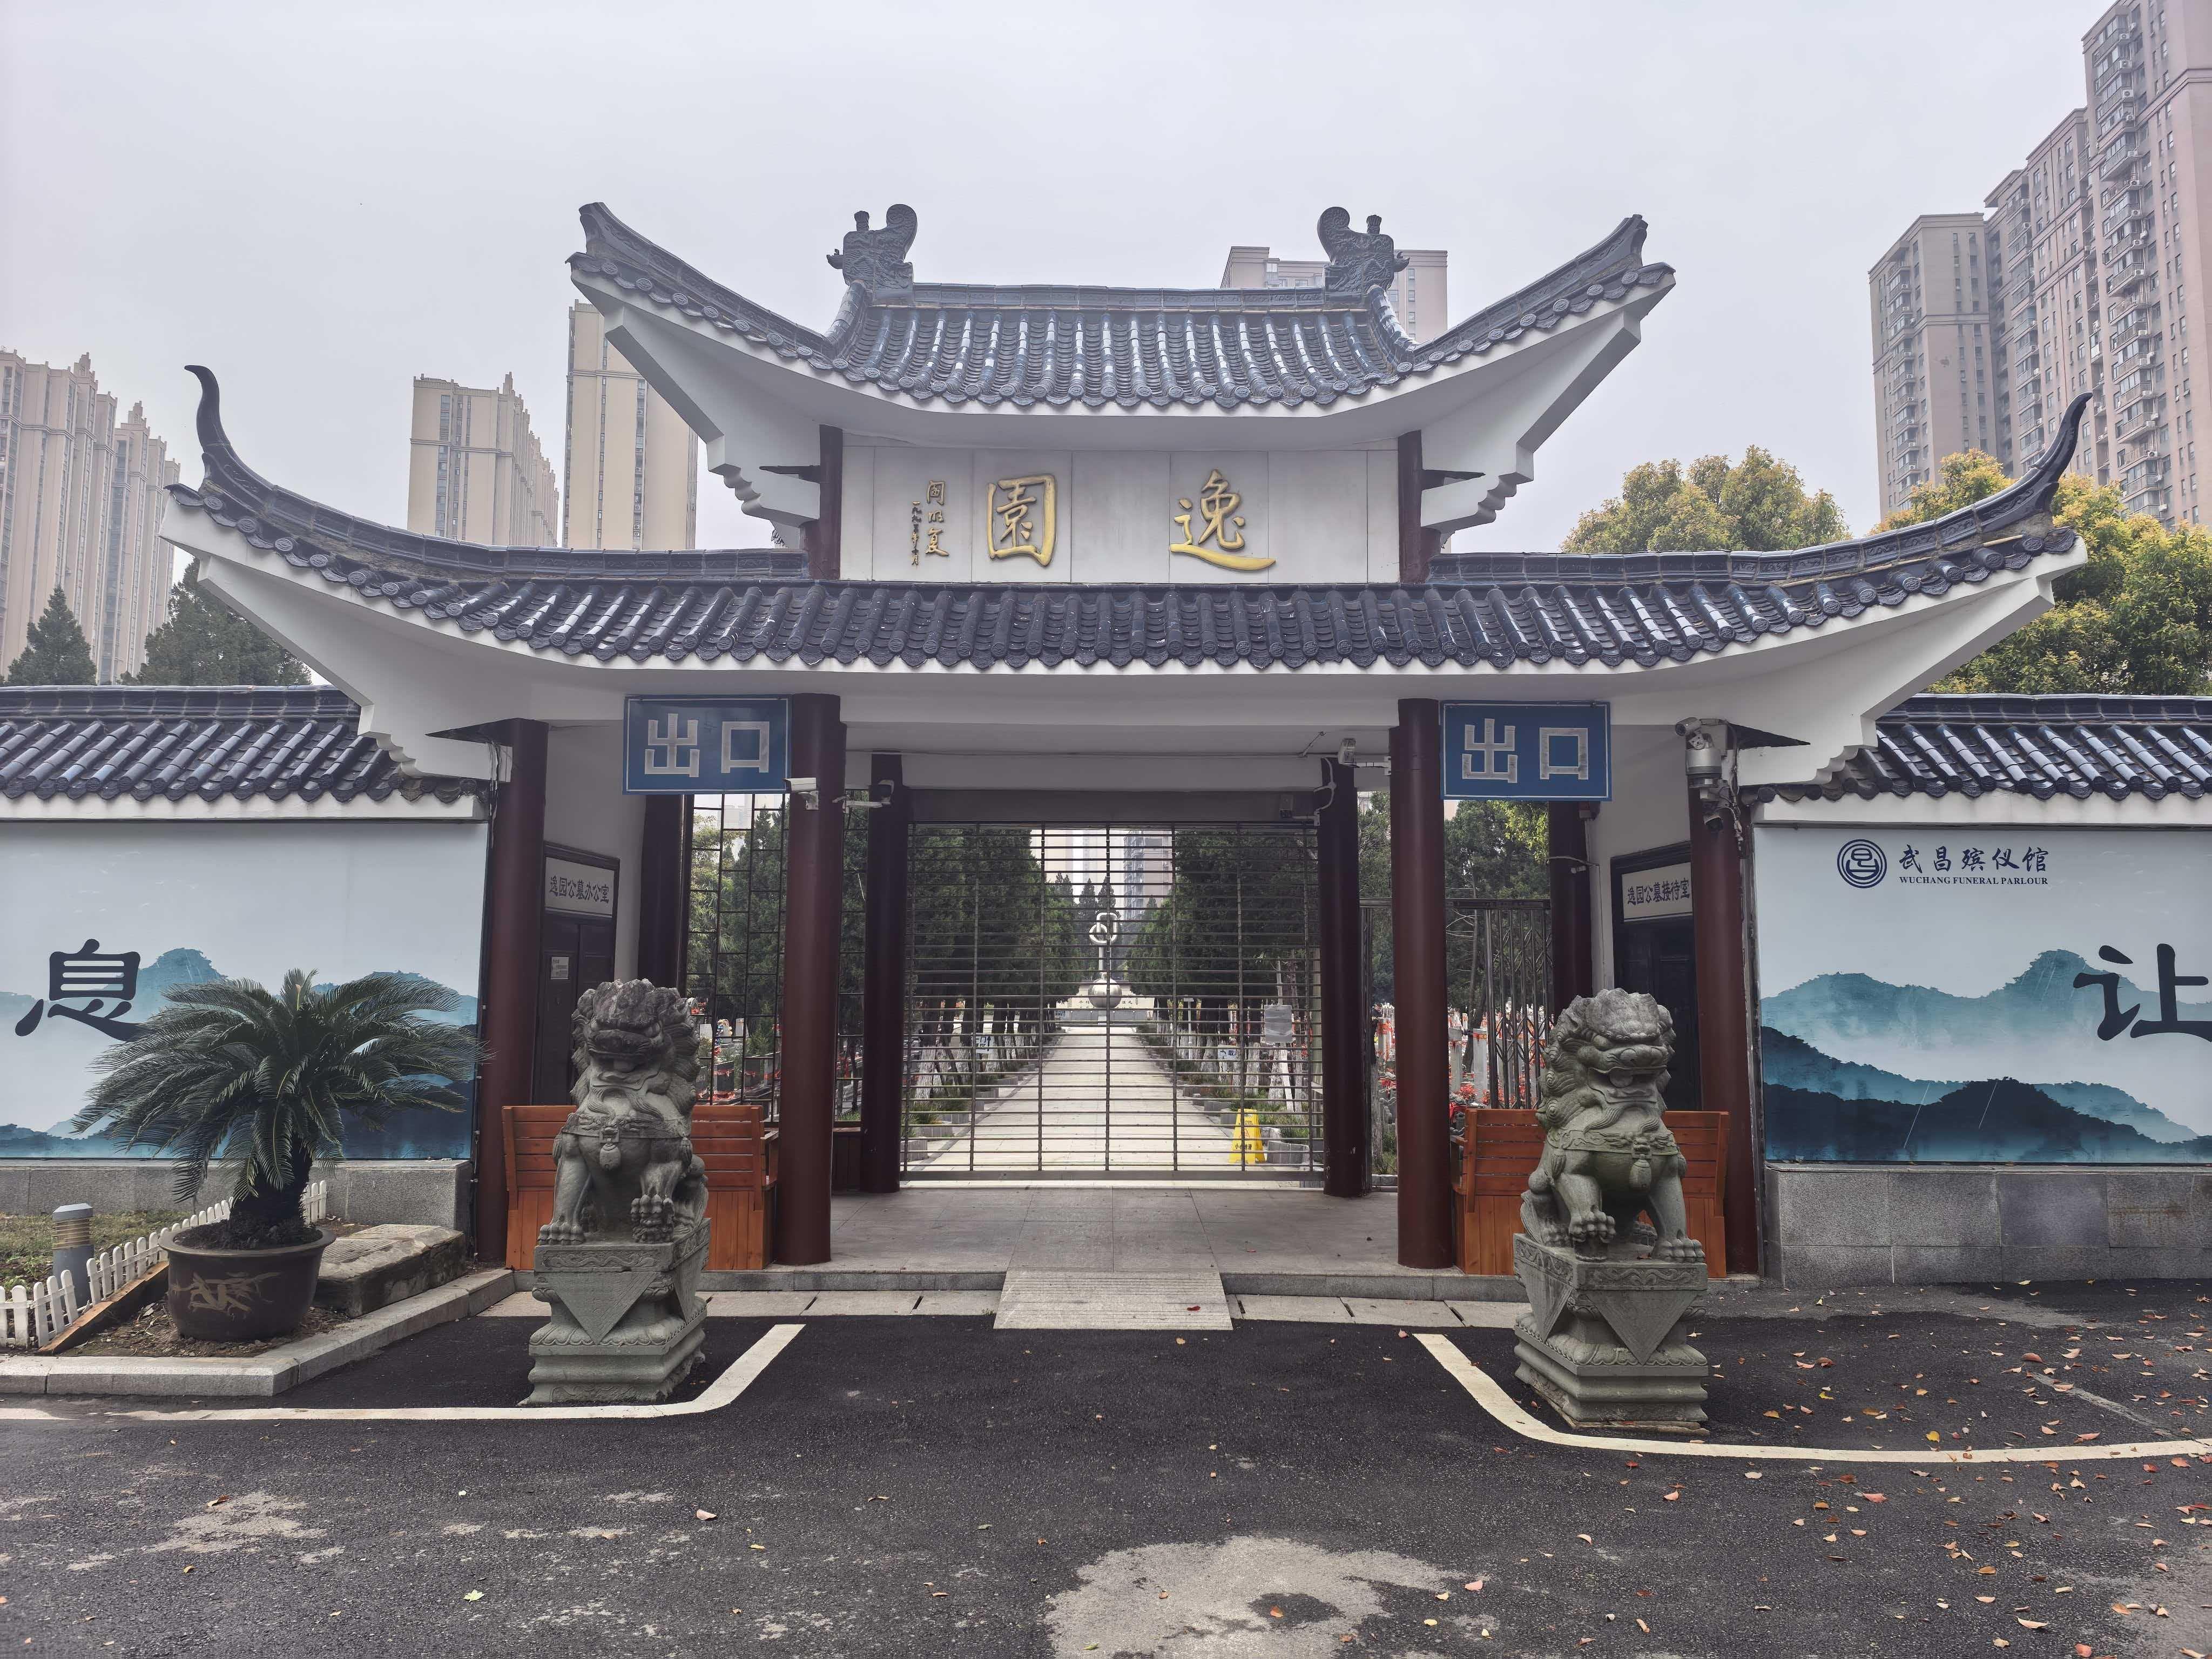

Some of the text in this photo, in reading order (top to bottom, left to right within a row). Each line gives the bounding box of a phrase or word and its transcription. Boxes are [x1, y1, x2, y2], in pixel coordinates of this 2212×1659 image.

[645, 713, 770, 777] 出口
[1462, 718, 1588, 783] 出口
[1899, 844, 2049, 874] 武昌殡仪馆
[1899, 876, 1951, 885] WUCHANG
[549, 875, 609, 903] 逸园公墓办公室
[1627, 878, 1690, 905] 逸园公墓接待室
[15, 939, 156, 1042] 息
[2073, 943, 2212, 1042] 让
